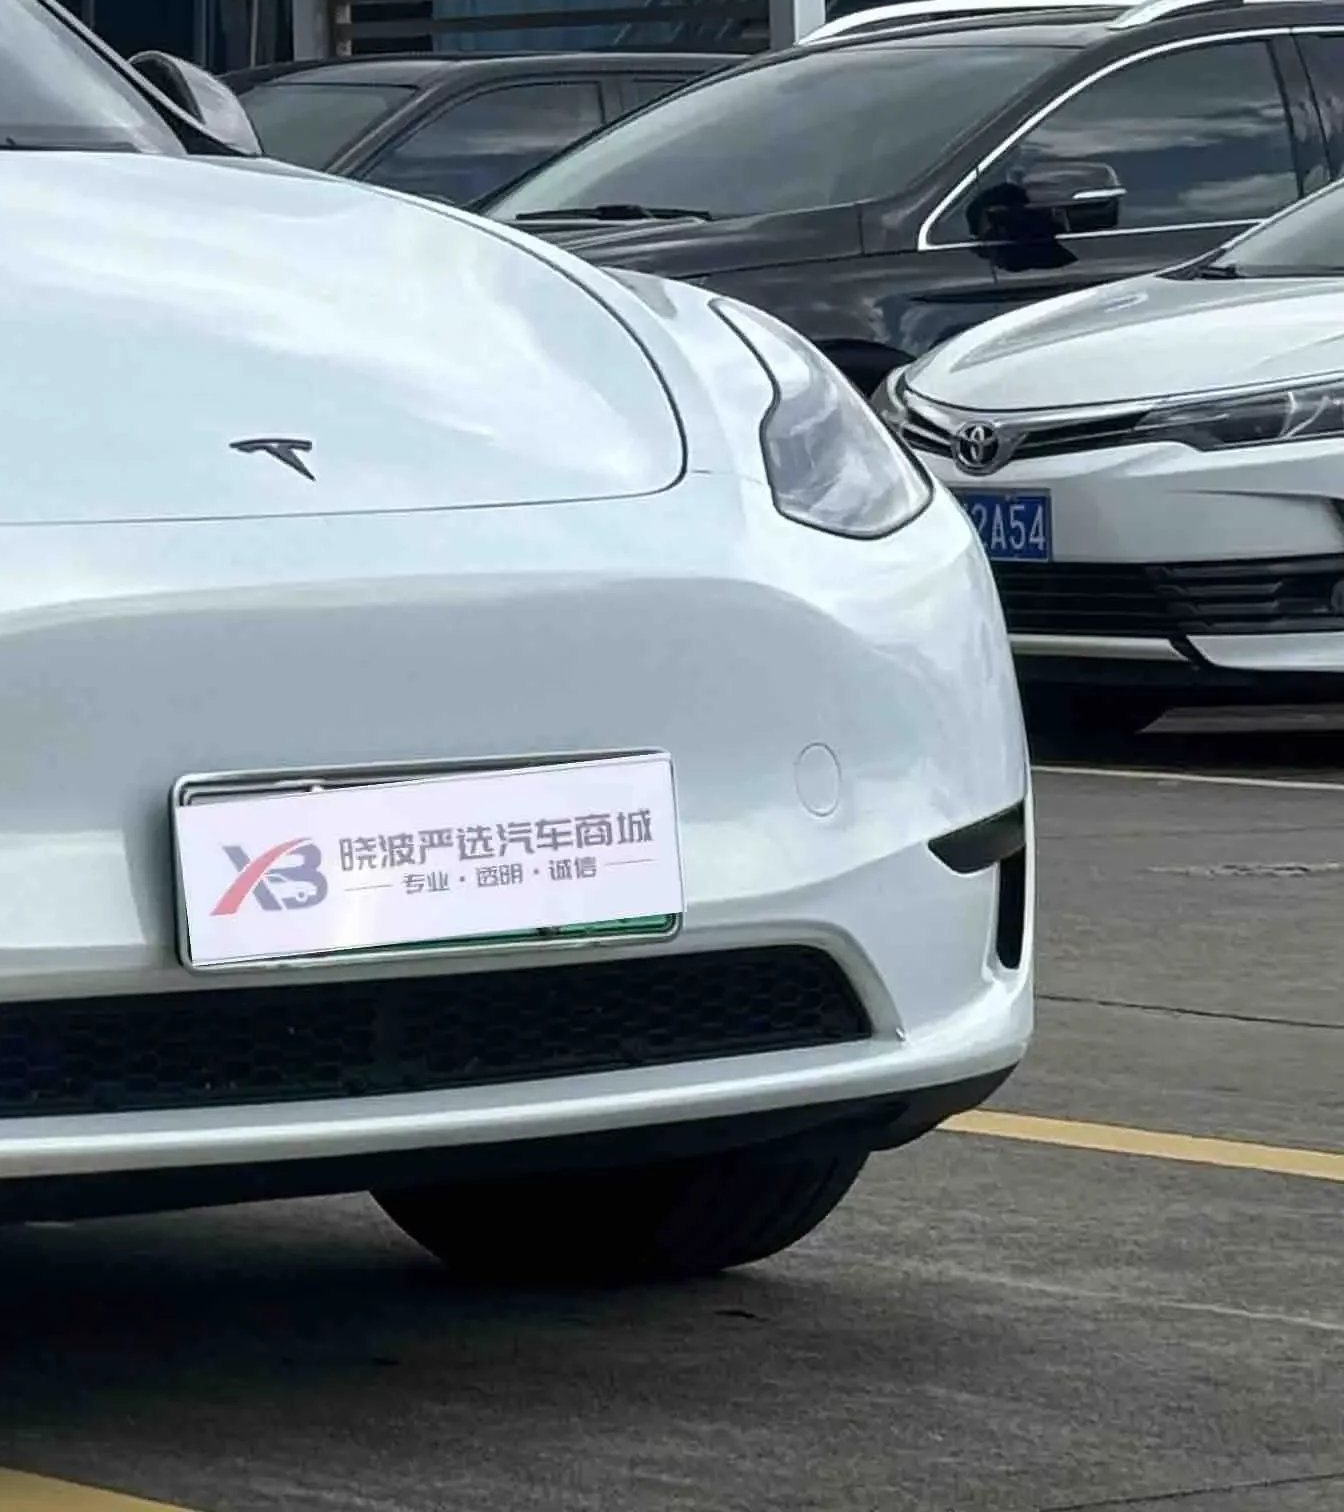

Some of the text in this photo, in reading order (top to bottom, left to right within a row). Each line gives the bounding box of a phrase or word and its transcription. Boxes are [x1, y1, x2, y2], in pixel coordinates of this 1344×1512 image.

[963, 503, 1046, 551] 2A54
[338, 808, 654, 872] 晓波严选汽车商城
